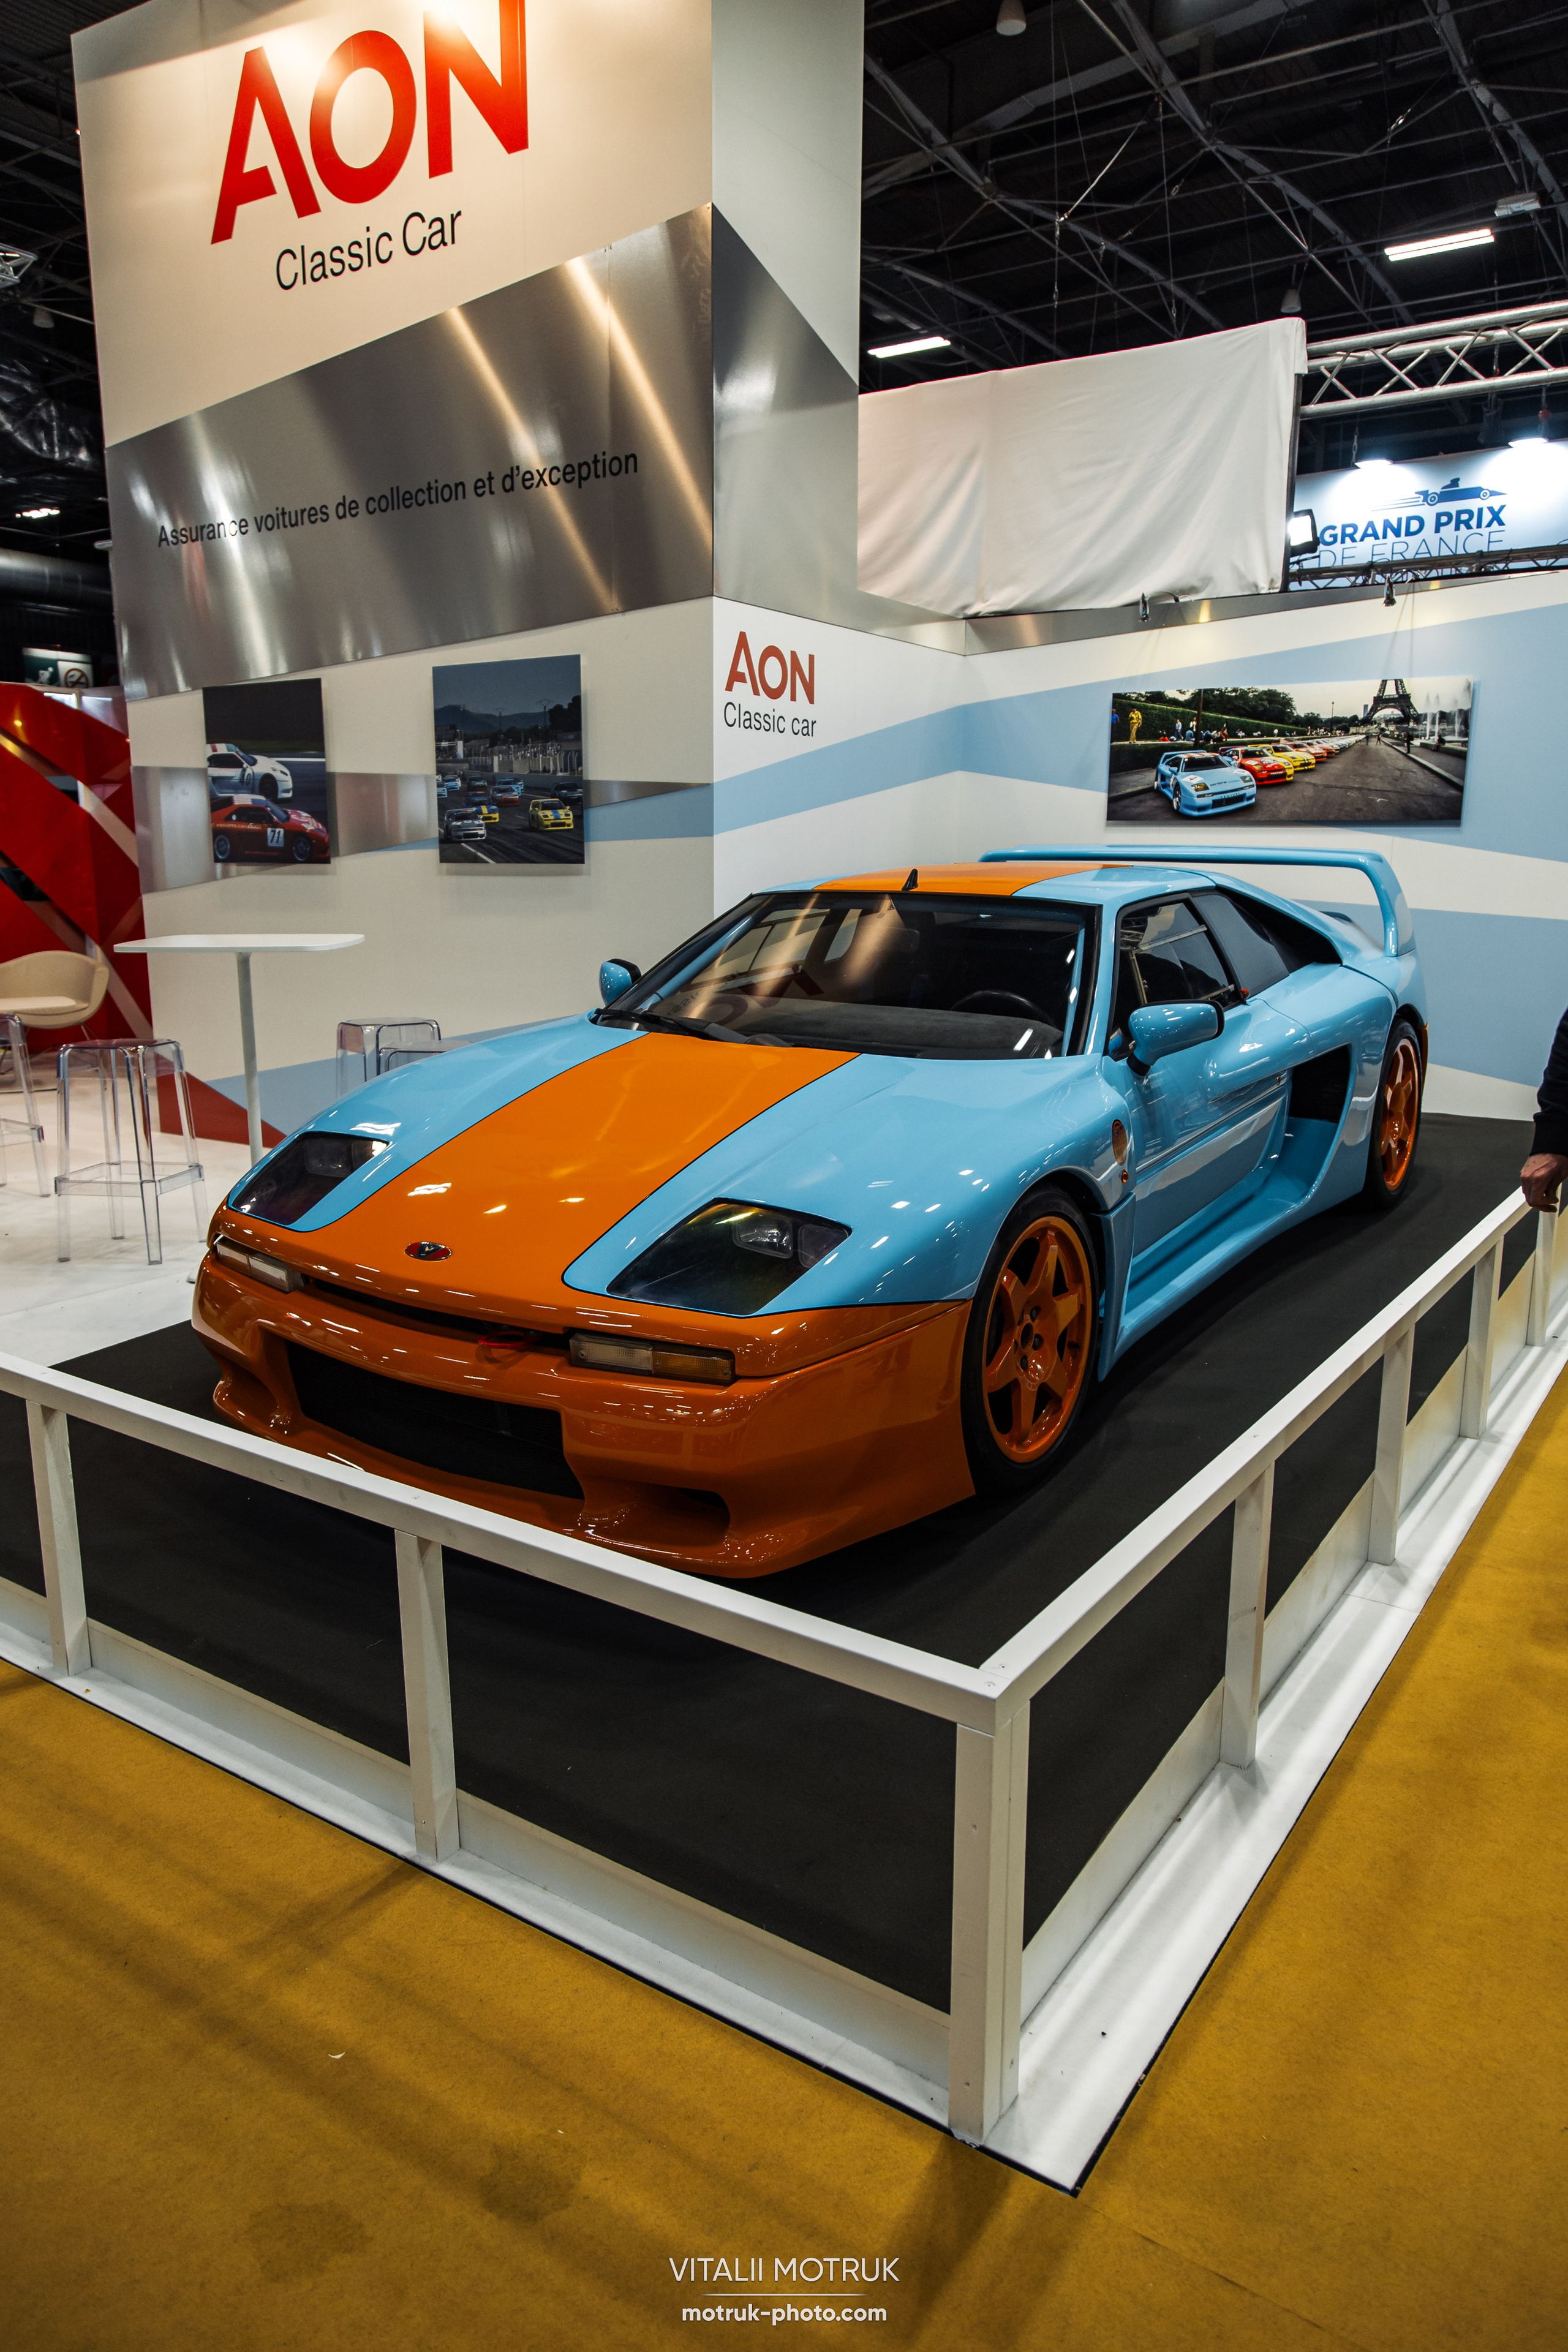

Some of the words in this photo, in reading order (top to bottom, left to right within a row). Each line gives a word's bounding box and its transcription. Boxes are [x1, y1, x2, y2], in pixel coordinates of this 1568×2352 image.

[211, 0, 529, 244] AON
[276, 226, 393, 291] Classic
[402, 210, 462, 256] Car
[157, 518, 249, 548] Assurance
[254, 504, 330, 532] voitures
[335, 495, 360, 520] de
[366, 479, 467, 515] collection
[473, 471, 494, 497] et
[501, 451, 638, 493] d'exception
[1319, 515, 1425, 546] GRAND
[1434, 504, 1507, 534] PRIX
[725, 630, 815, 705] AON
[723, 701, 786, 734] Classic
[791, 717, 816, 737] car
[270, 829, 281, 843] 71
